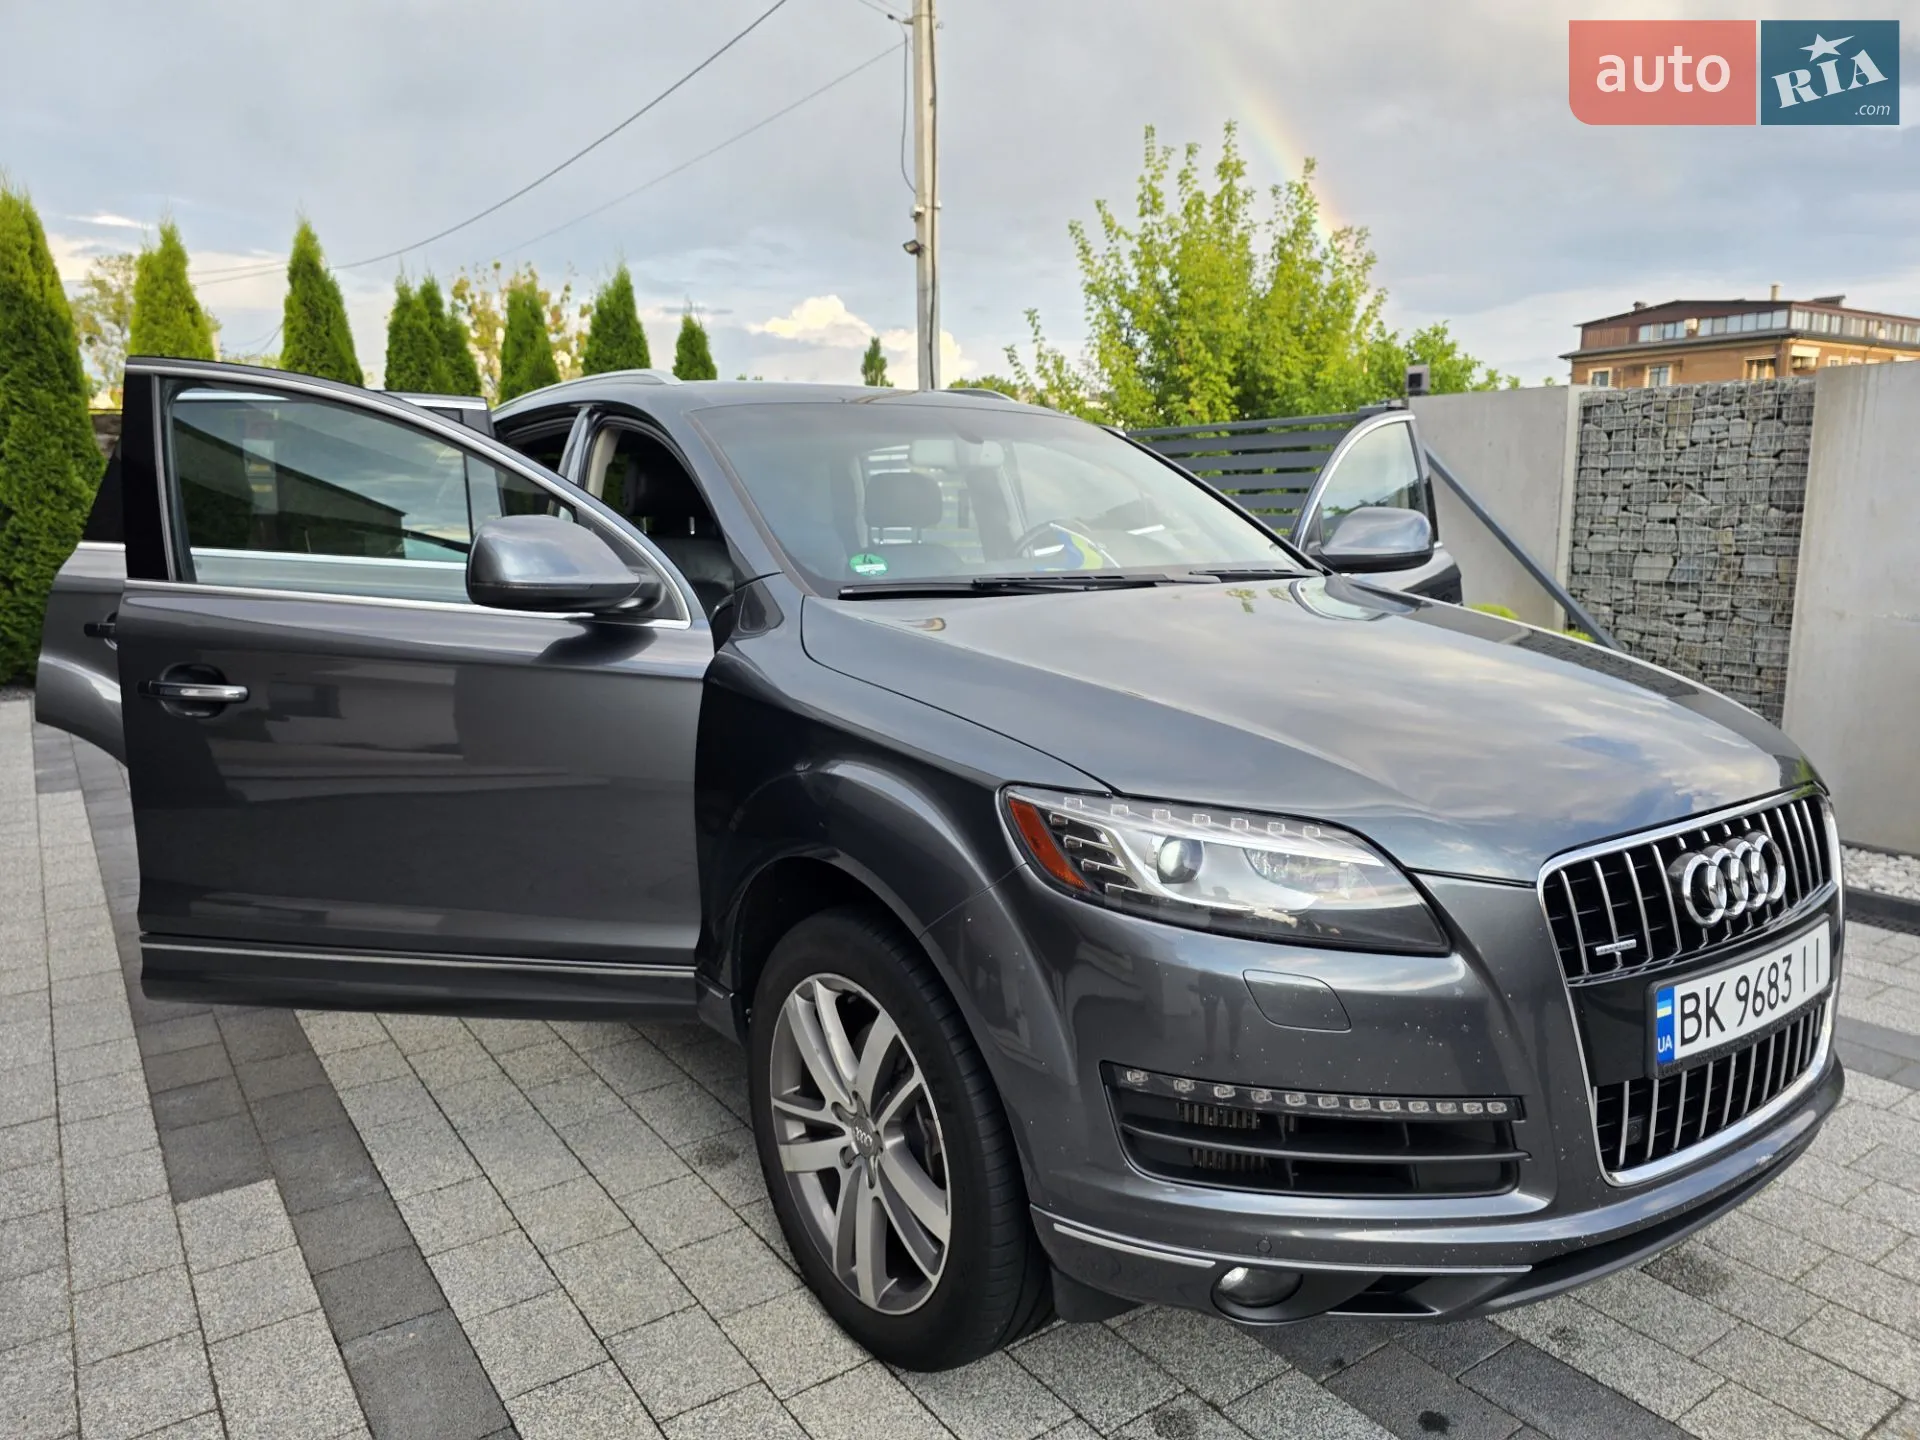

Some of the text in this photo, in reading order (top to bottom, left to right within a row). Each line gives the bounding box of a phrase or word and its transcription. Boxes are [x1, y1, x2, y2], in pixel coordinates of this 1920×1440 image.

[1680, 981, 1727, 1047] BK
[1735, 952, 1793, 1028] 9683
[1657, 1035, 1673, 1053] UA
